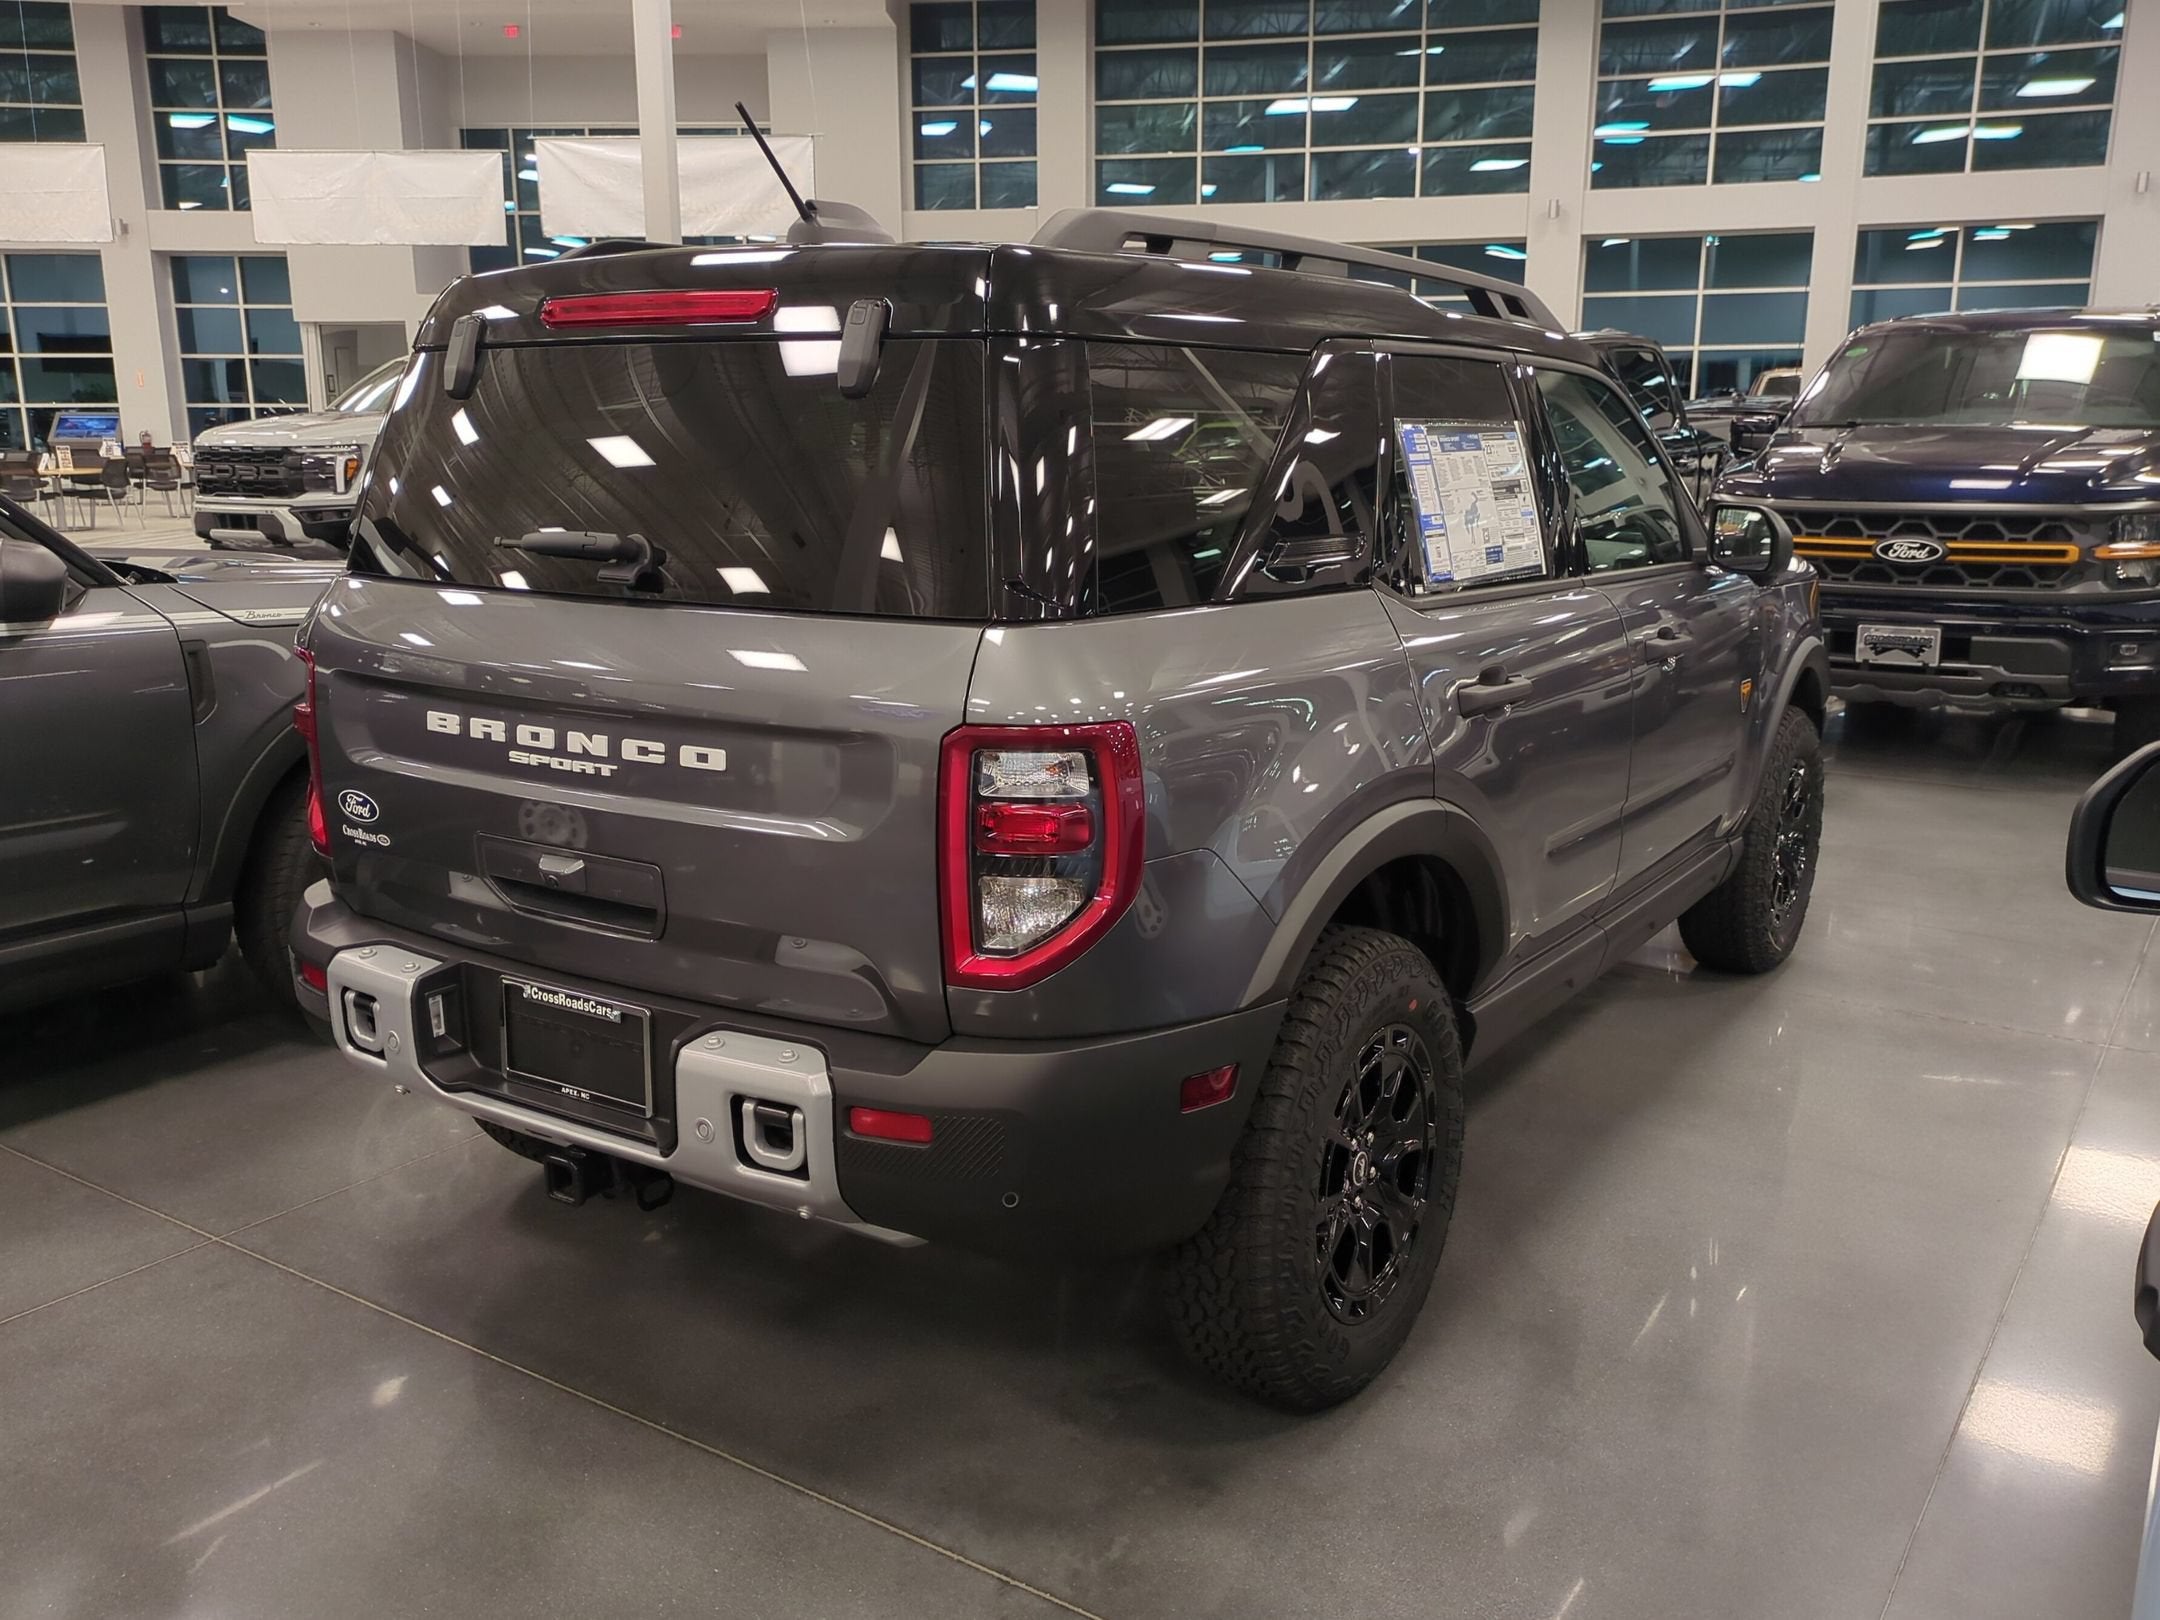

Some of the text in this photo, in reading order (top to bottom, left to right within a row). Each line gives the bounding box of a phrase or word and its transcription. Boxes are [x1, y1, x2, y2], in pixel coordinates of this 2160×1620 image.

[1887, 541, 1931, 559] Ford
[426, 710, 726, 771] BRONCO
[508, 750, 618, 777] SPORT
[345, 792, 371, 818] Ford
[531, 986, 612, 1016] CrossRoadsCars
